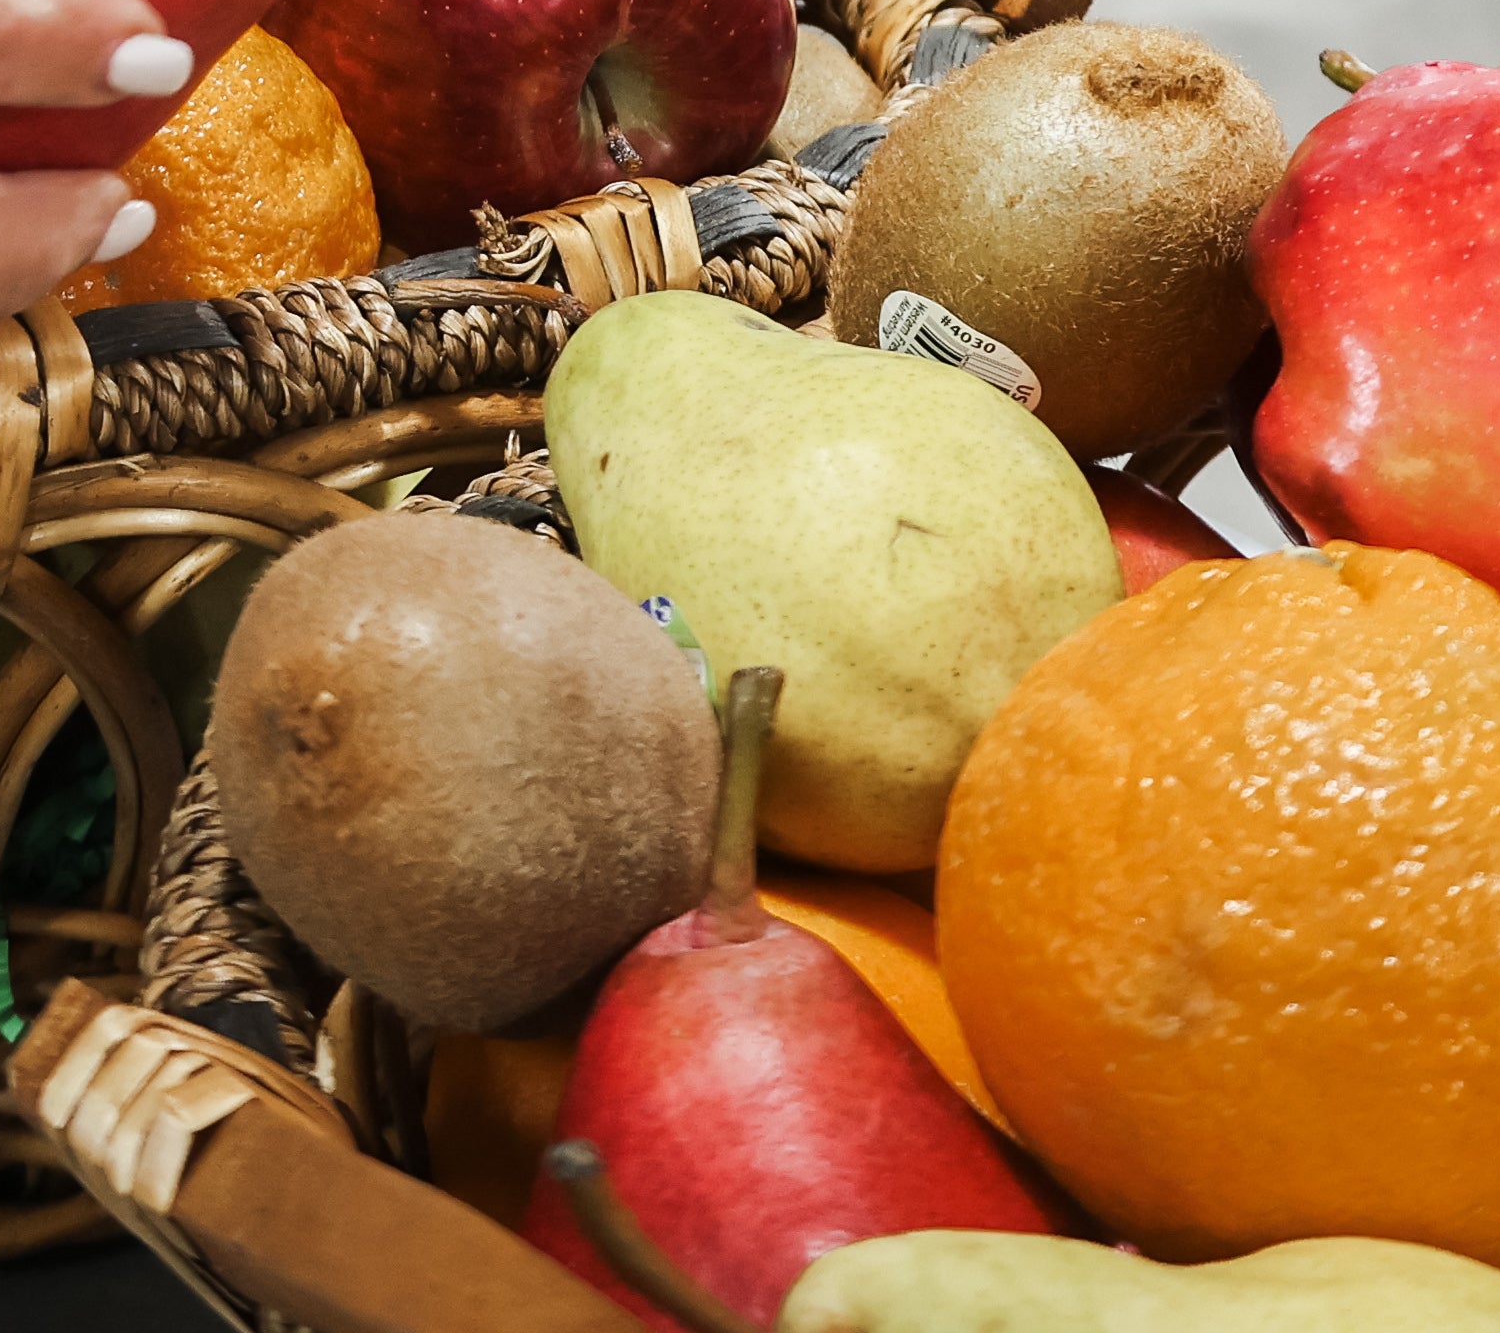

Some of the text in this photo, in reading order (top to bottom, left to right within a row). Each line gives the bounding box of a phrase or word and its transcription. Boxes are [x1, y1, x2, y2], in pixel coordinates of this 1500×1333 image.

[882, 296, 912, 339] Marketing
[902, 300, 928, 336] Western
[940, 315, 997, 354] #4030
[1011, 384, 1035, 404] US
